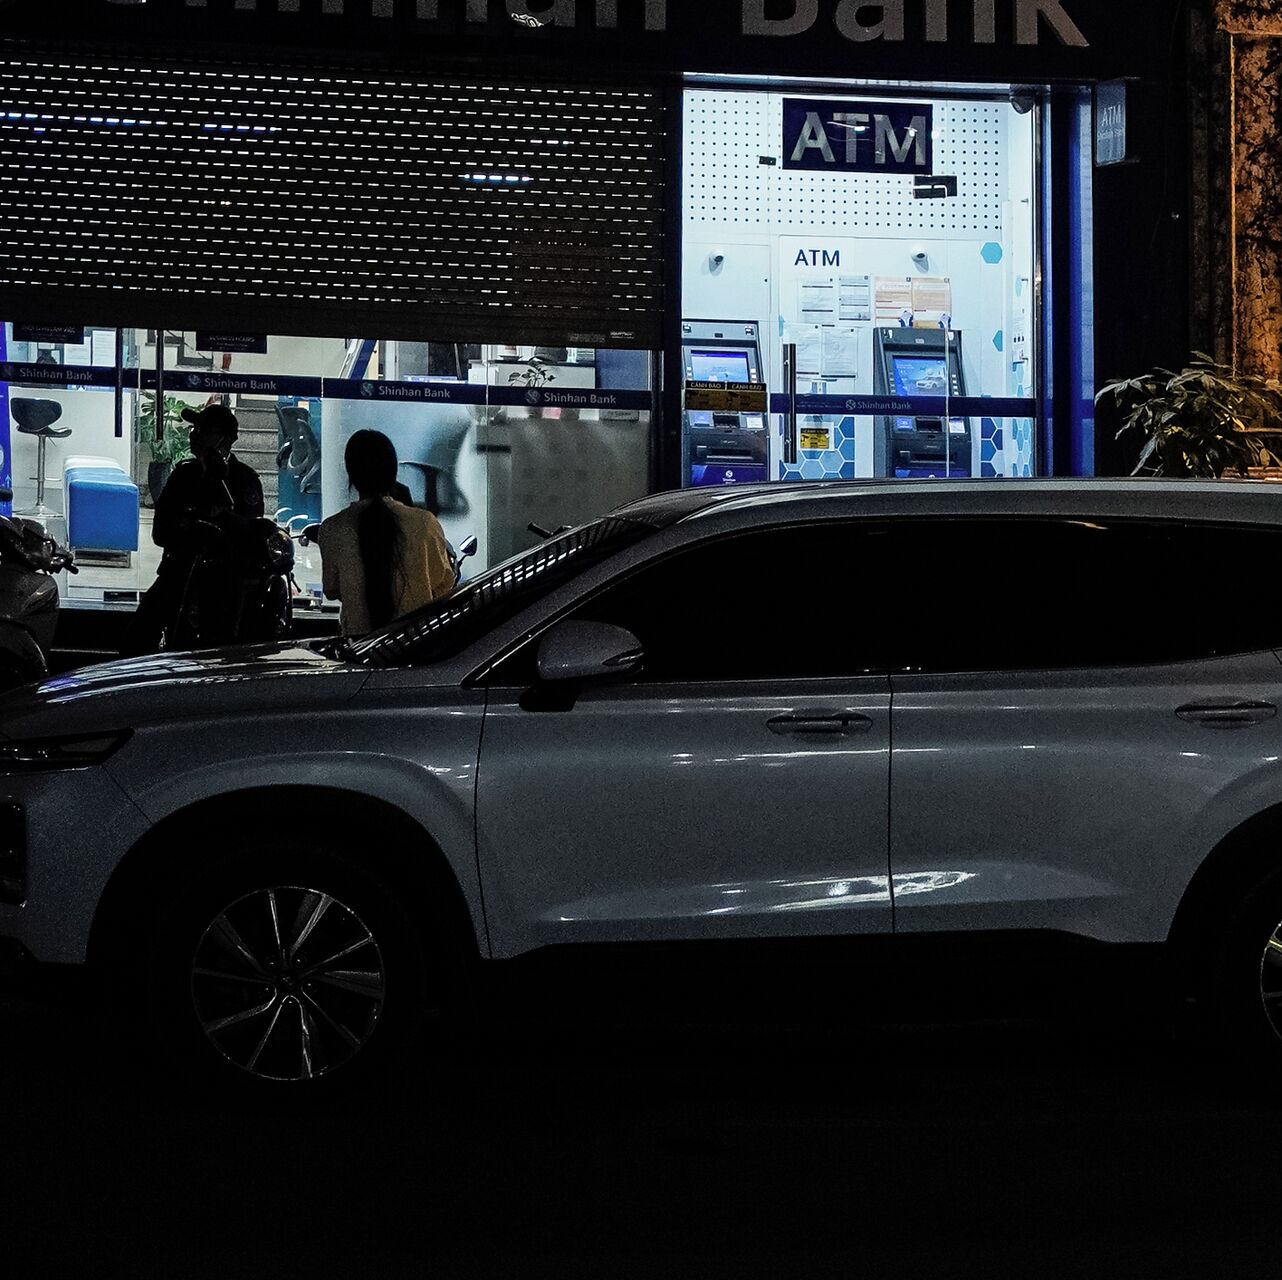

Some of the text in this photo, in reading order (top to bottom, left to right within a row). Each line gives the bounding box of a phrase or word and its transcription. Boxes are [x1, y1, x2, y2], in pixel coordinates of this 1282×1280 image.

[1101, 104, 1122, 127] ATM
[790, 111, 927, 167] ATM
[794, 248, 841, 267] ATM
[19, 367, 94, 382] Shinhan Bank
[203, 377, 277, 391] Shinhan Bank
[378, 385, 451, 399] Shinhan Bank
[543, 391, 617, 405] Shinhan Bank
[856, 400, 913, 411] Shinhan Bank
